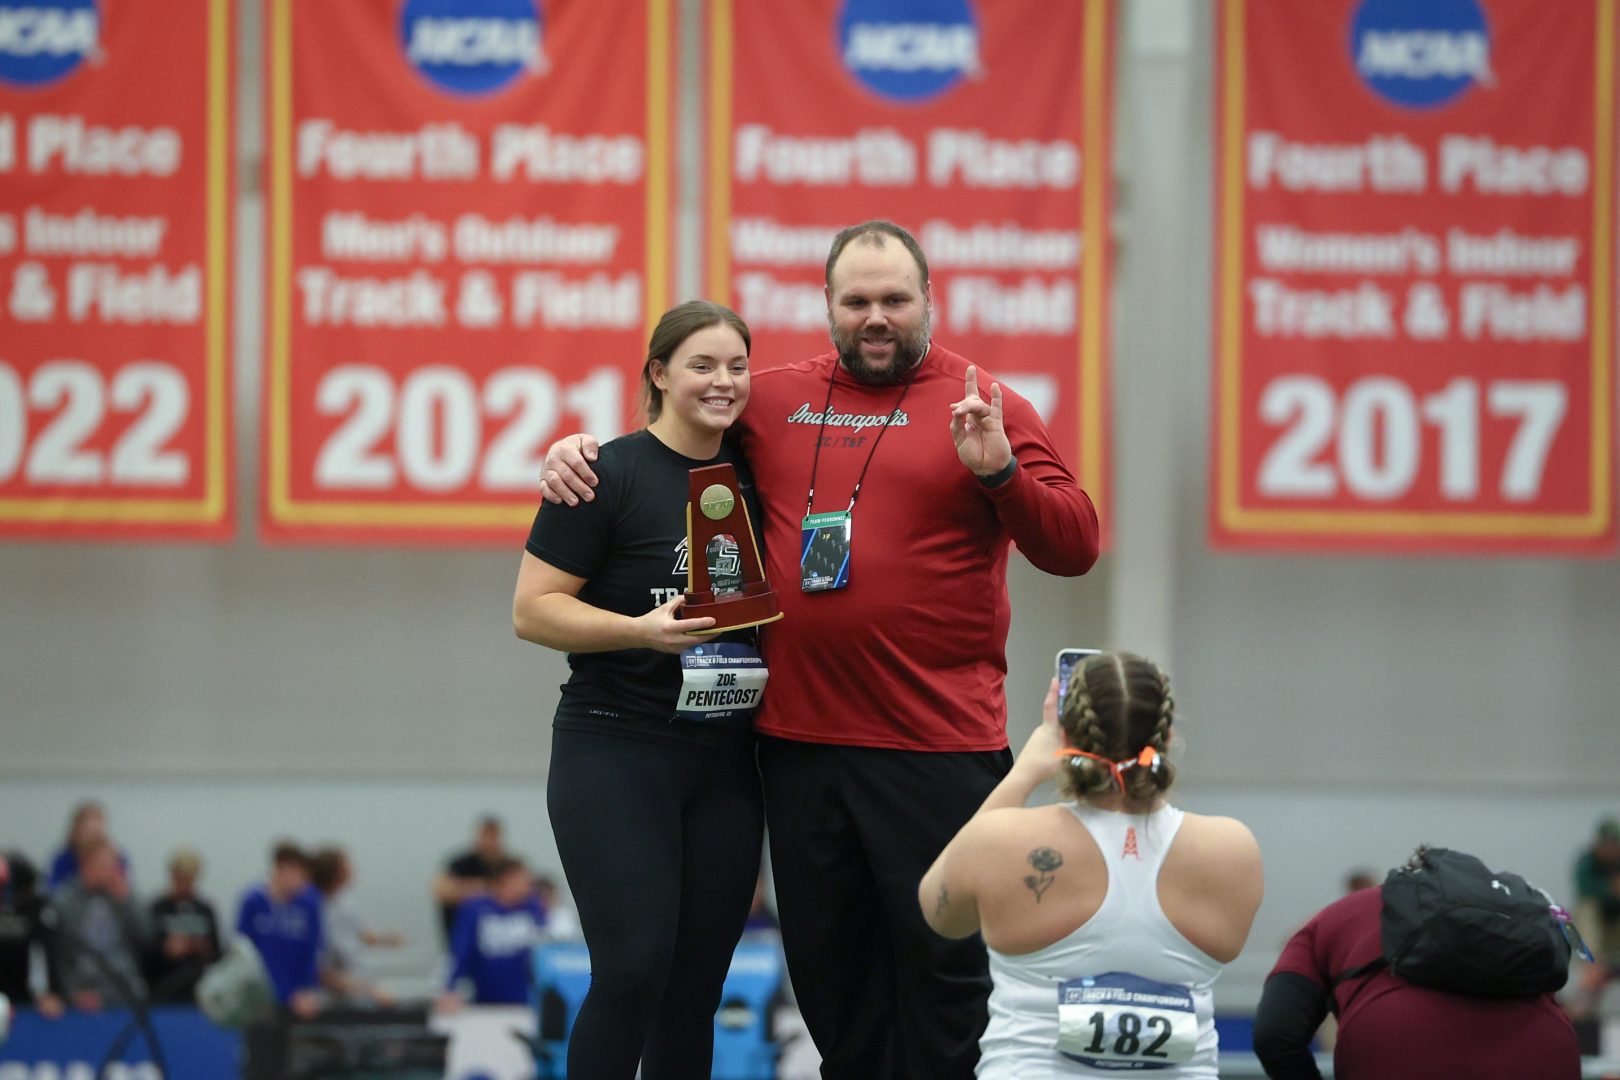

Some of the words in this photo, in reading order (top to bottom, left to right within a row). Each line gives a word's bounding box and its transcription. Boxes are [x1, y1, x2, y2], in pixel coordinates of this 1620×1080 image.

[0, 8, 96, 56] CAA
[409, 17, 541, 66] NCAA
[848, 22, 976, 72] NCAA
[1361, 30, 1489, 79] NCAA
[28, 114, 182, 177] Place
[298, 118, 480, 181] Fourth
[491, 122, 642, 184] Place
[736, 125, 916, 185] Fourth
[928, 129, 1081, 189] Place
[1248, 131, 1427, 192] Fourth
[1440, 136, 1589, 195] Place
[26, 206, 166, 256] Indoor
[322, 210, 447, 263] Men's
[453, 212, 618, 264] Outdoor
[921, 220, 1081, 269] Outdoor
[1256, 223, 1440, 275] Women's
[1447, 226, 1580, 276] Indoor
[10, 260, 56, 323] &
[67, 262, 200, 325] Field
[299, 265, 447, 327] Track
[456, 269, 502, 328] &
[511, 270, 641, 329] Field
[946, 275, 1076, 335] Field
[1251, 278, 1394, 338] Track
[1405, 282, 1448, 340] &
[1460, 283, 1587, 341] Field
[314, 364, 624, 491] 2021
[788, 402, 909, 433] Indianapolis
[1258, 374, 1569, 499] 2017
[685, 688, 759, 707] PENTECOST
[716, 673, 737, 687] ZOE
[1084, 1011, 1172, 1058] 182
